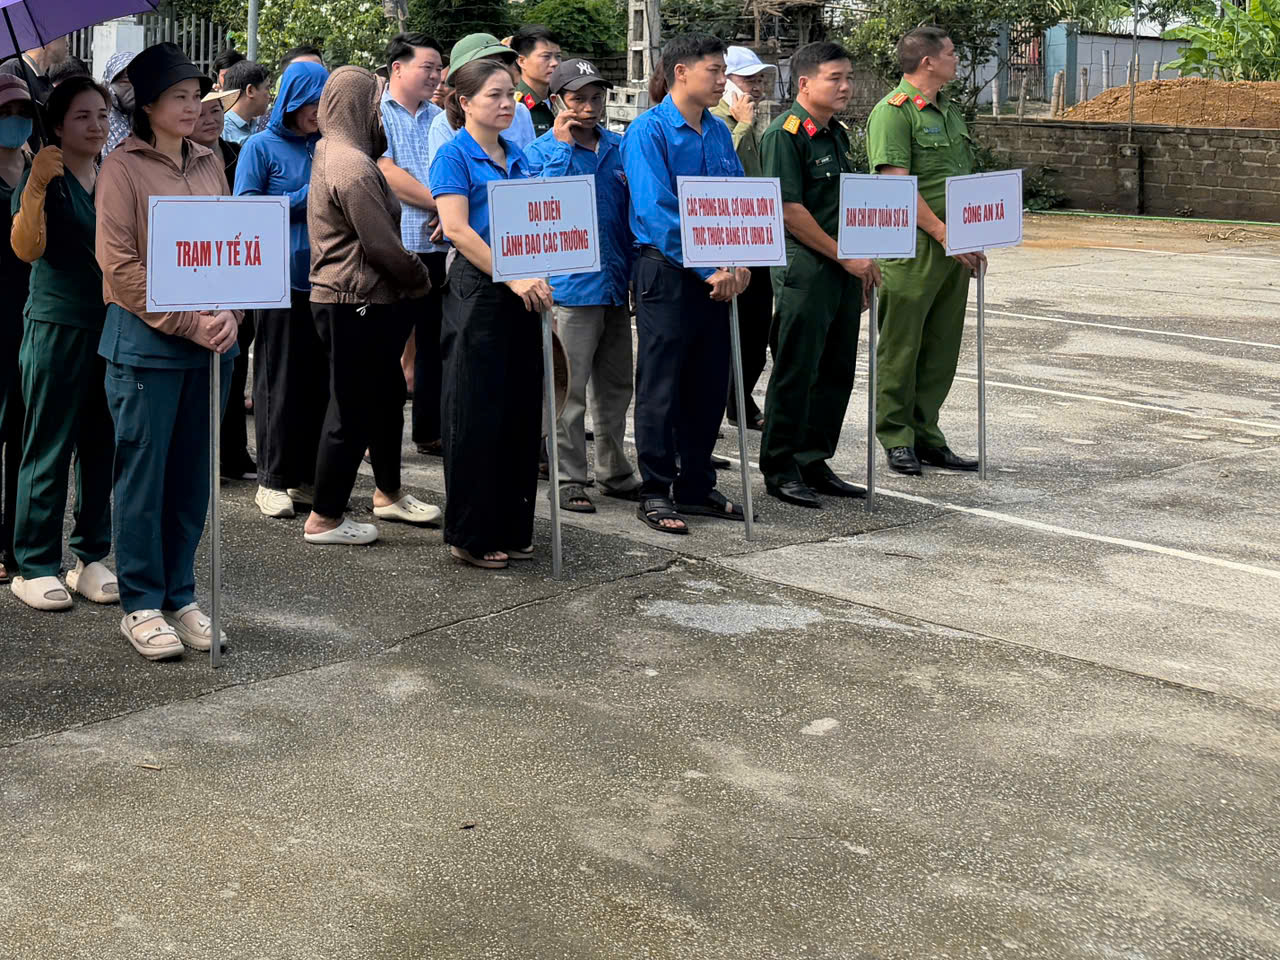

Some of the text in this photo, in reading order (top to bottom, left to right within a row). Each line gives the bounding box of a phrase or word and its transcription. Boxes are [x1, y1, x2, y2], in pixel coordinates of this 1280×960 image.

[528, 196, 561, 227] ĐẠI DIỆN
[686, 194, 698, 216] CÁC
[698, 193, 717, 216] PHÒNG
[768, 197, 775, 220] VỊ
[846, 202, 908, 231] BAN CHỈ HUY QUÂN SỰ XÃ
[962, 198, 1005, 224] CÔNG AN XÃ
[501, 225, 589, 259] LÃNH ĐẠO CÁC TRƯỜNG
[692, 225, 707, 250] TRỰC
[707, 222, 725, 250] THUỘC
[750, 226, 765, 245] UBND
[765, 222, 774, 245] XÃ
[176, 232, 262, 272] TRẠM Y TẾ XÃ
